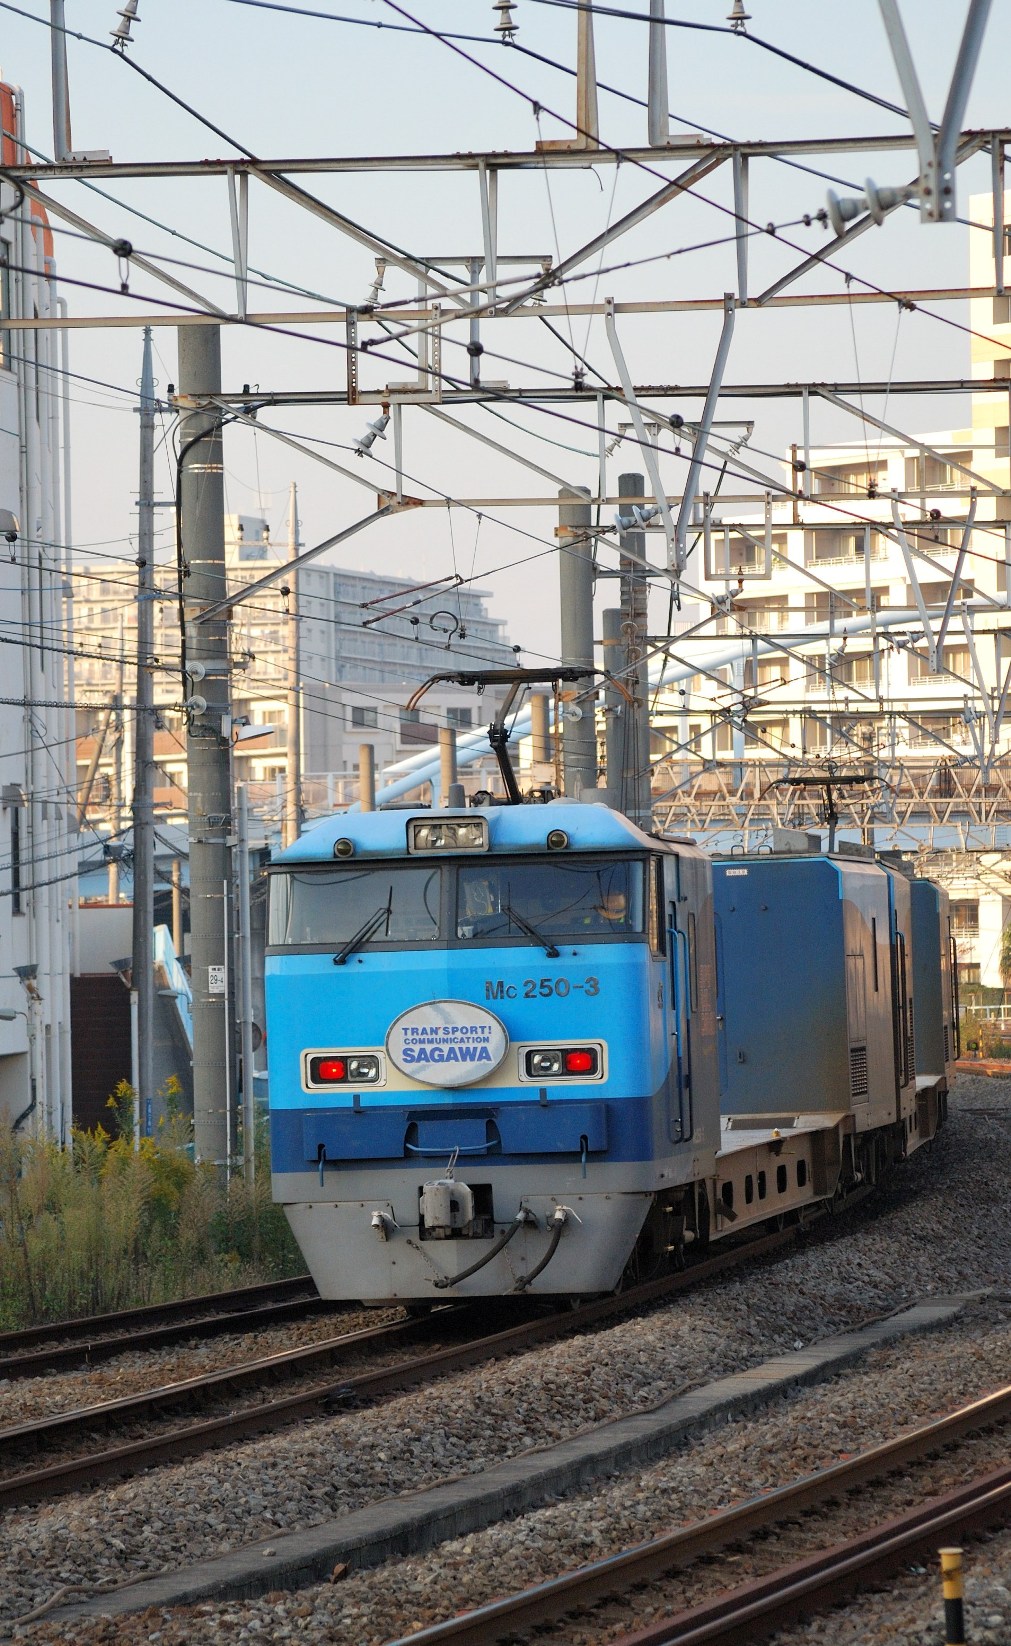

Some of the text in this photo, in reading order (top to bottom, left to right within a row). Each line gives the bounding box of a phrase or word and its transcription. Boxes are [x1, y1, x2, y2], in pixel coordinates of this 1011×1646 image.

[485, 976, 601, 1001] Mc 250-3
[403, 1036, 490, 1045] COMMUNICATION
[402, 1046, 492, 1064] SAGAWA
